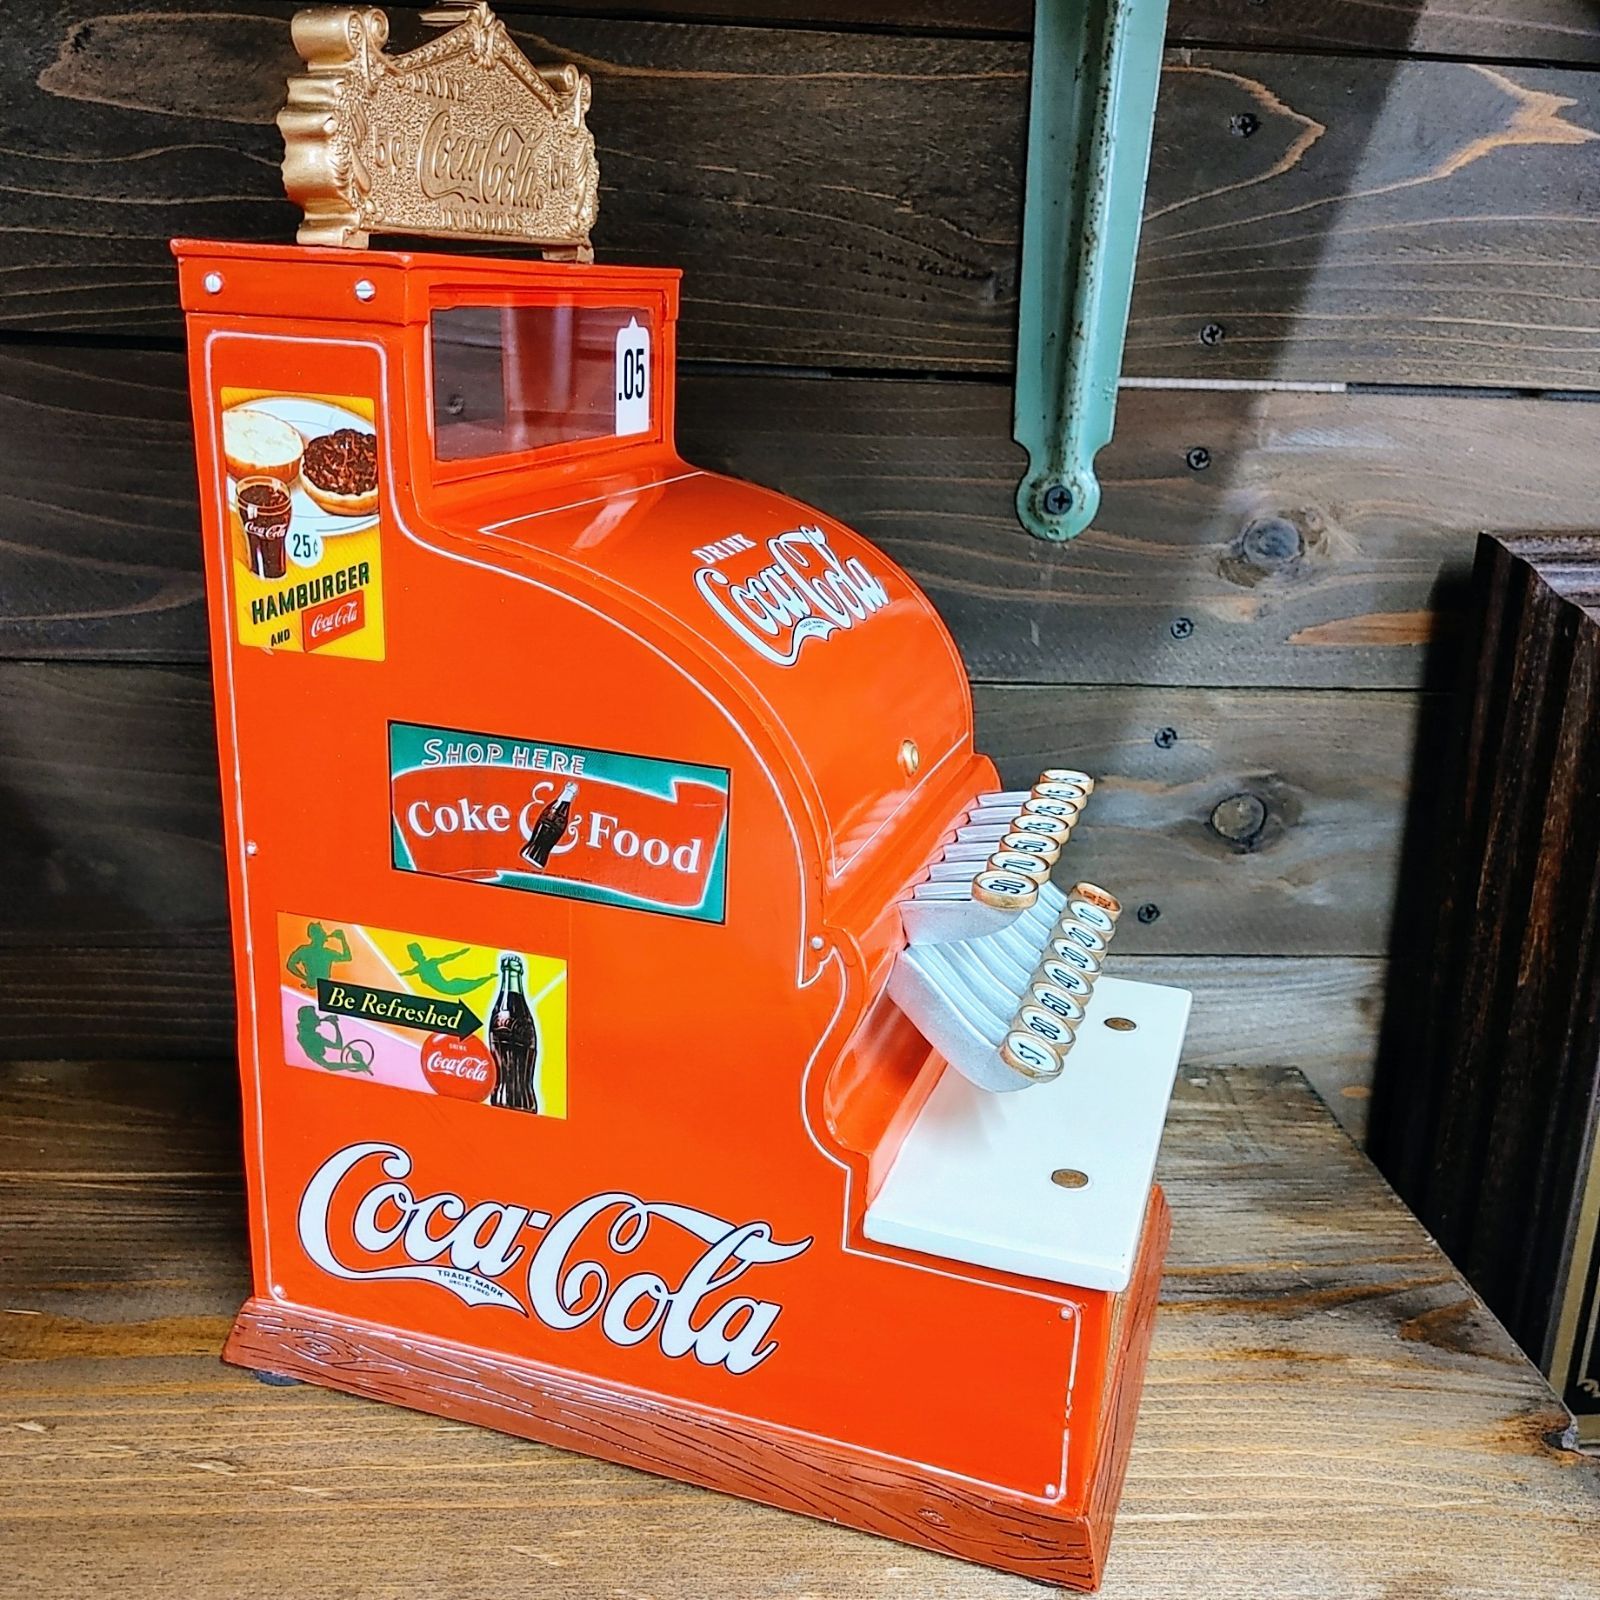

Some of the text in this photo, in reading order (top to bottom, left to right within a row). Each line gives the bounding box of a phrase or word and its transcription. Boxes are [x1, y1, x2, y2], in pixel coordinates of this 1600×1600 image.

[618, 348, 645, 401] .05
[292, 533, 318, 558] 25¢
[691, 533, 758, 565] DRINK
[251, 561, 370, 625] HAMBURGER
[693, 524, 890, 667] Coca-Cola
[310, 601, 359, 638] Coca-Cola
[270, 628, 291, 647] AND
[421, 738, 586, 775] SHOP HERE
[407, 797, 512, 838] Coke
[585, 810, 703, 875] Food
[1012, 839, 1048, 853] 50
[987, 878, 1027, 895] 90
[1067, 926, 1097, 948] 20
[1060, 946, 1090, 970] 30
[1051, 967, 1081, 991] 40
[328, 986, 357, 1010] Be
[361, 993, 464, 1031] Refreshed
[1040, 992, 1072, 1017] 60
[1029, 1015, 1062, 1041] 80
[426, 1050, 490, 1083] Coca-Cola
[298, 1141, 814, 1375] Coca-Cola
[437, 1269, 504, 1298] TRADE MARK
